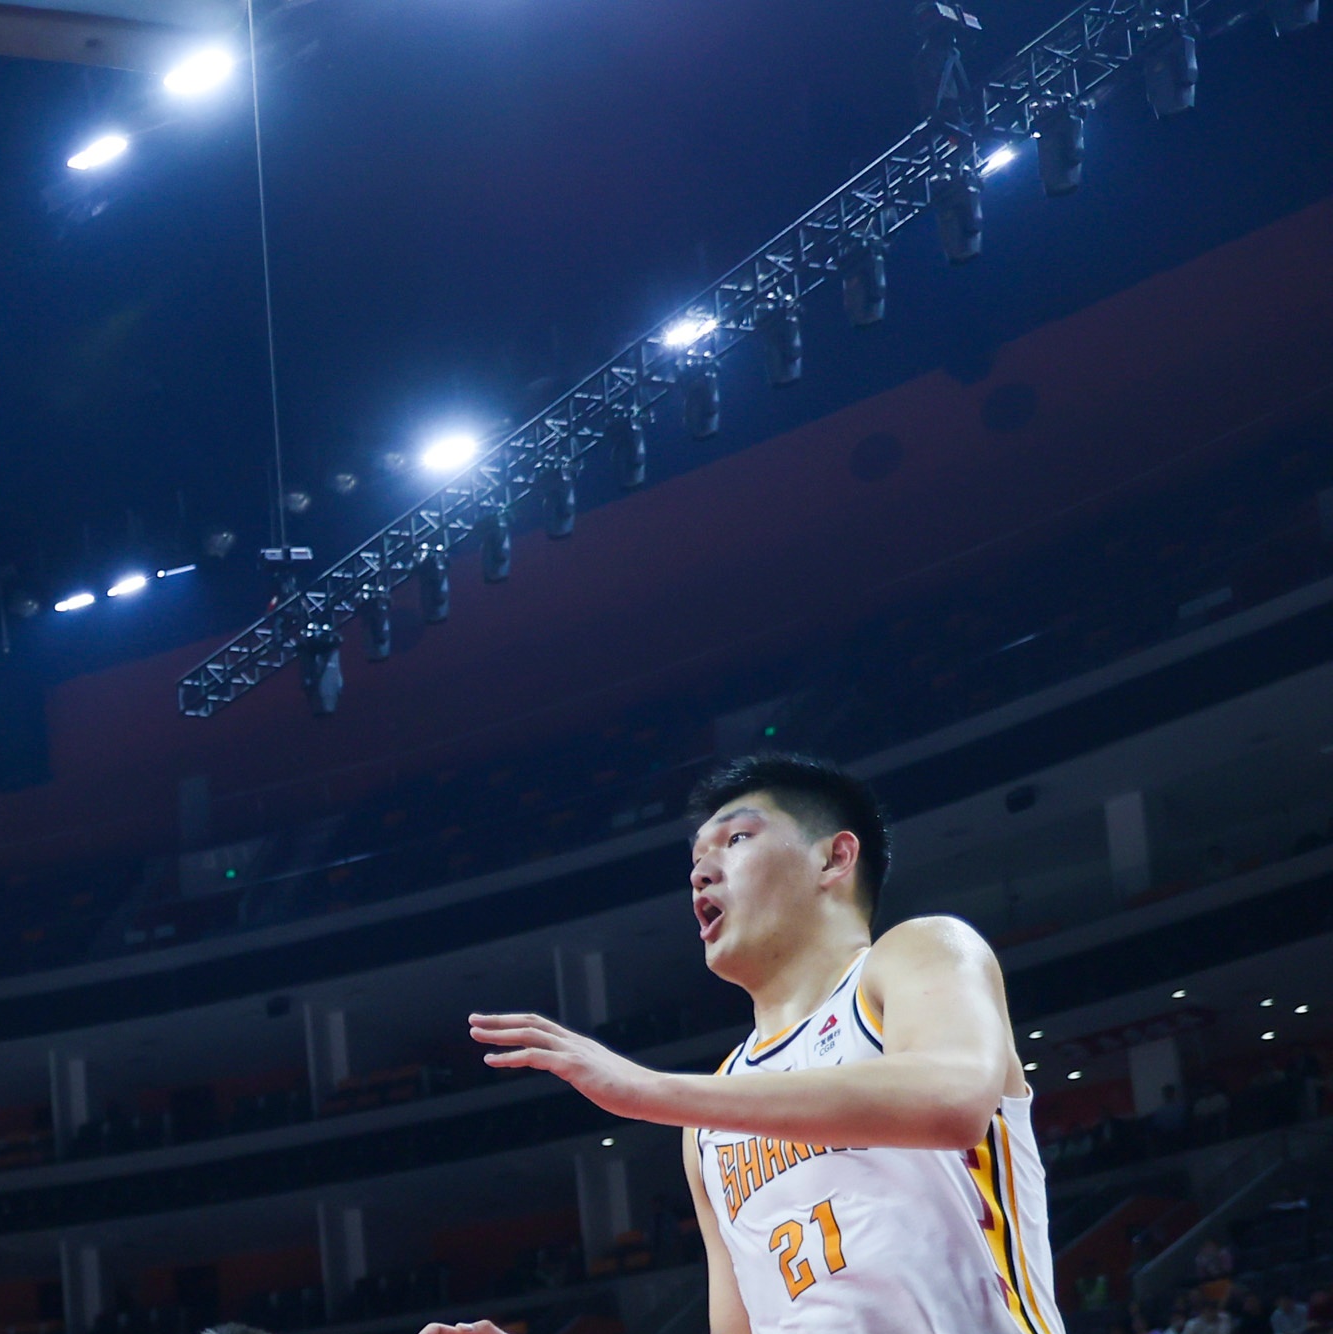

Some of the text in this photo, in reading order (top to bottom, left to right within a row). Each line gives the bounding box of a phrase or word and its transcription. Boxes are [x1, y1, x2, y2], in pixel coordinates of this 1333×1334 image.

[819, 1041, 836, 1057] CGB
[715, 1137, 869, 1225] SHAN
[768, 1199, 847, 1302] 21
